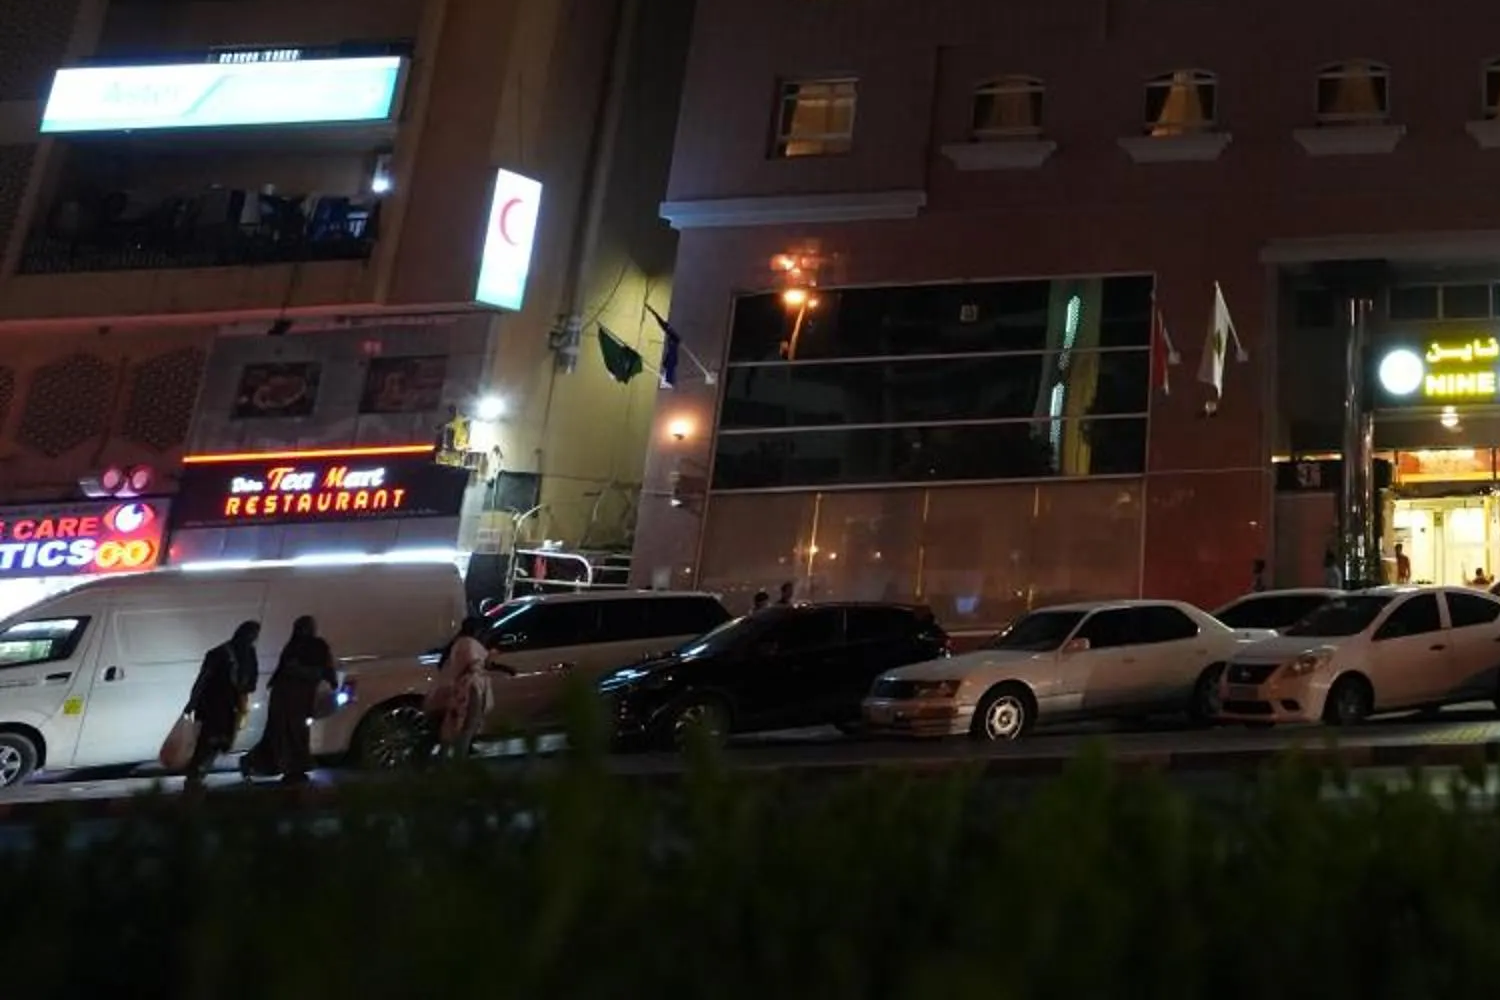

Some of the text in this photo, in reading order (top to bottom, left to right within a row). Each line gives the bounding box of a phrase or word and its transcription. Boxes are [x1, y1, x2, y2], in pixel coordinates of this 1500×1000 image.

[1424, 337, 1499, 363] ناين
[1424, 371, 1497, 396] NINE
[267, 466, 316, 491] Tea
[322, 466, 386, 489] Mart
[224, 489, 405, 516] RESTAURANT
[13, 517, 99, 540] CARE
